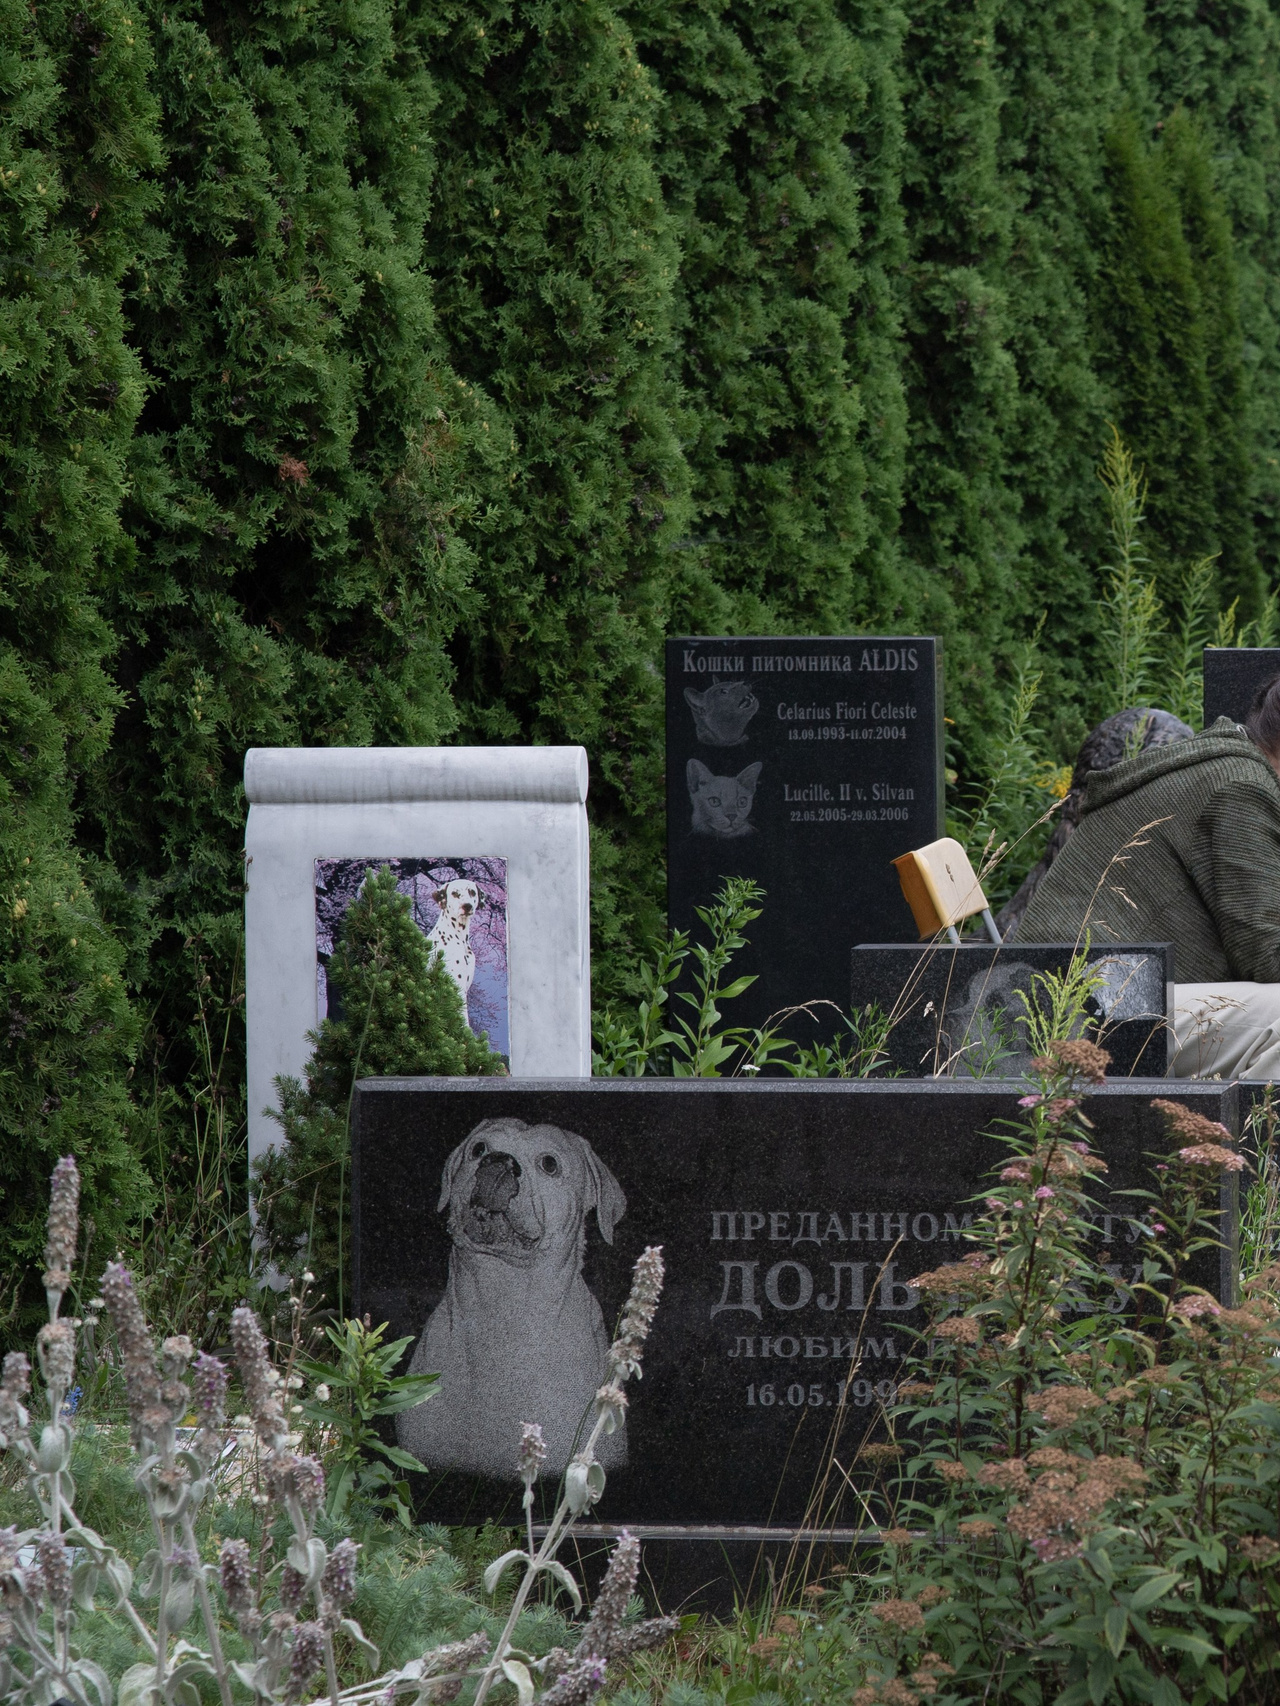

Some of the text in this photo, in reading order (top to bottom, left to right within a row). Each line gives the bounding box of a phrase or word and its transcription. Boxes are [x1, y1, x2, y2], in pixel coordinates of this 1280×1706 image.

[683, 648, 919, 673] Кошки питомника ALDIS
[777, 702, 918, 720] Celarius Fiori Celeste
[872, 783, 915, 801] Silvan
[727, 1335, 908, 1361] ЛЮБИМ.
